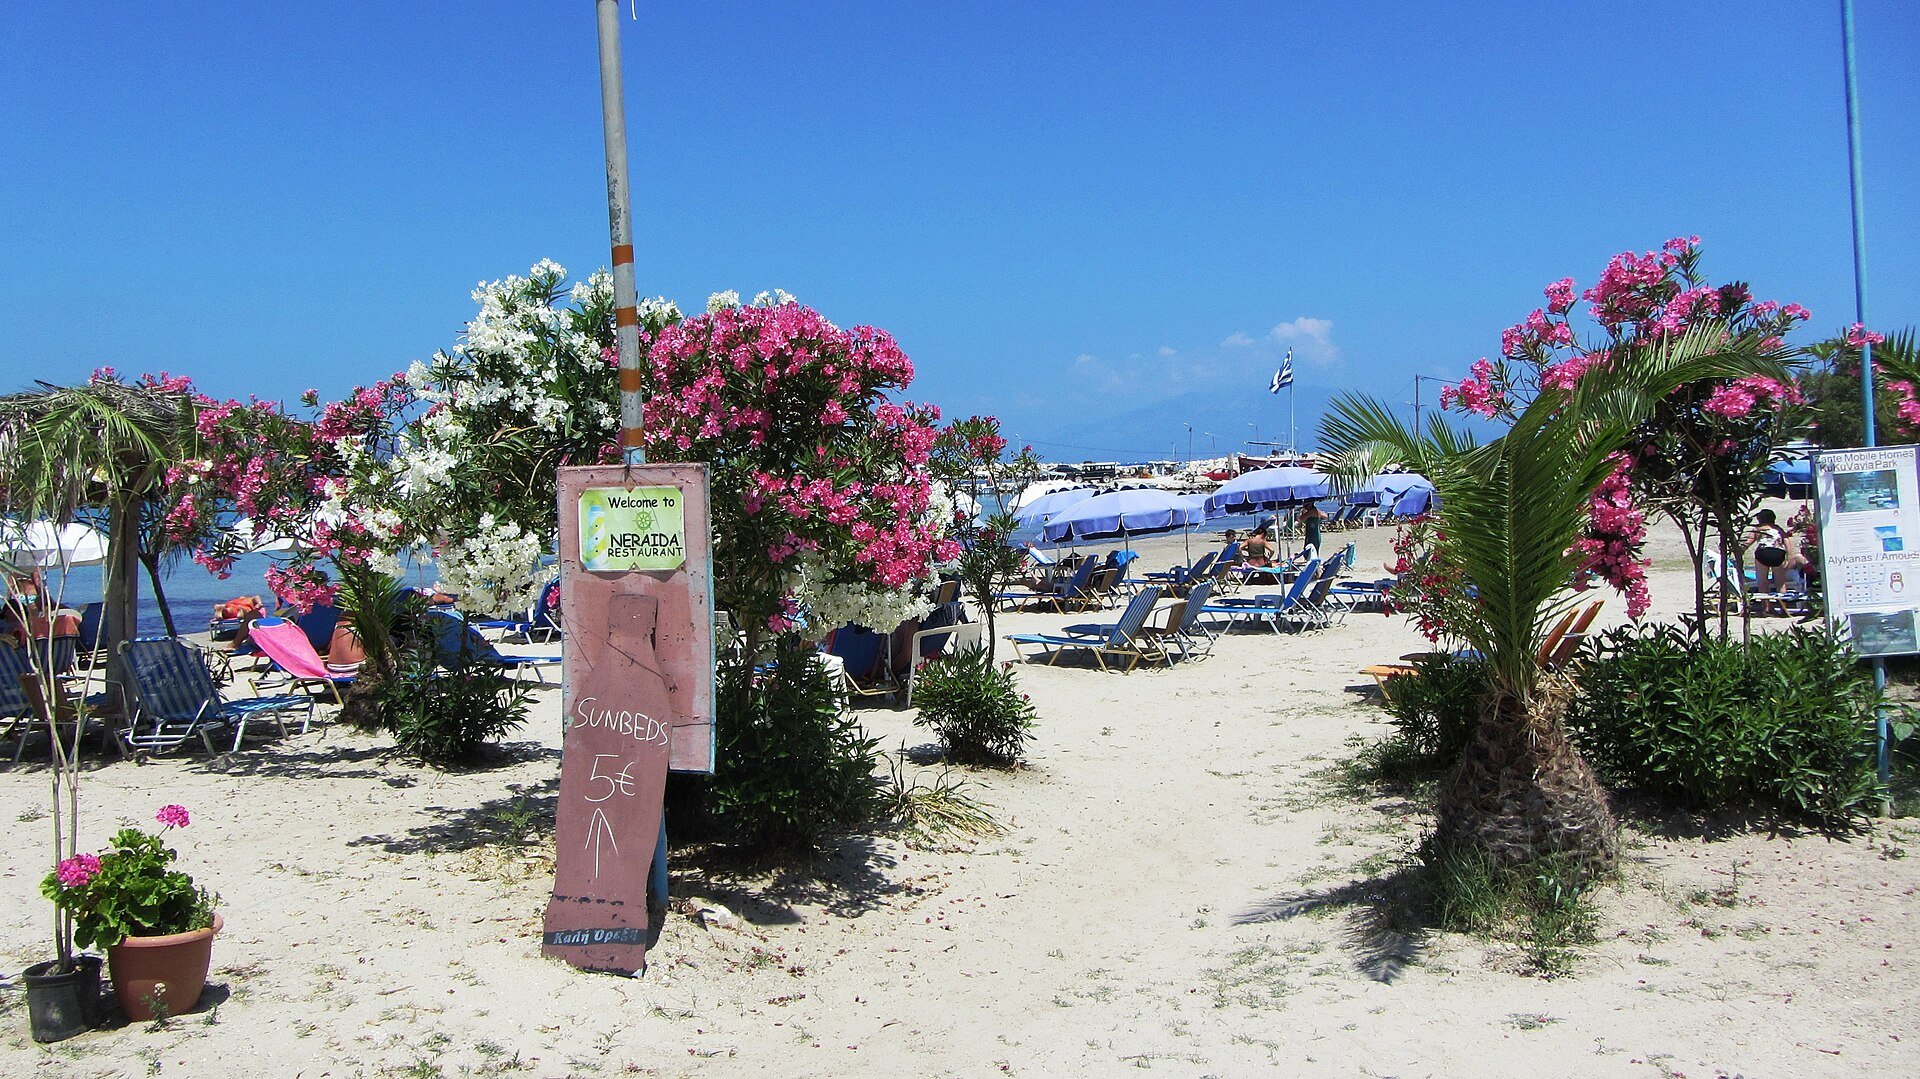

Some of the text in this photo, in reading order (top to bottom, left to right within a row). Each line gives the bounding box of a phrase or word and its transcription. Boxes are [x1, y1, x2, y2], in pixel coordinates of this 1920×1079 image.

[1814, 450, 1914, 464] Zante Mobile Homes
[608, 496, 675, 508] Welcome to
[610, 533, 679, 548] NERAIDA
[607, 547, 683, 557] RESTAURANT
[1828, 554, 1873, 566] Alykanas
[574, 697, 668, 746] SUNBEDS
[584, 754, 636, 802] 5€
[552, 930, 590, 945] Καλή
